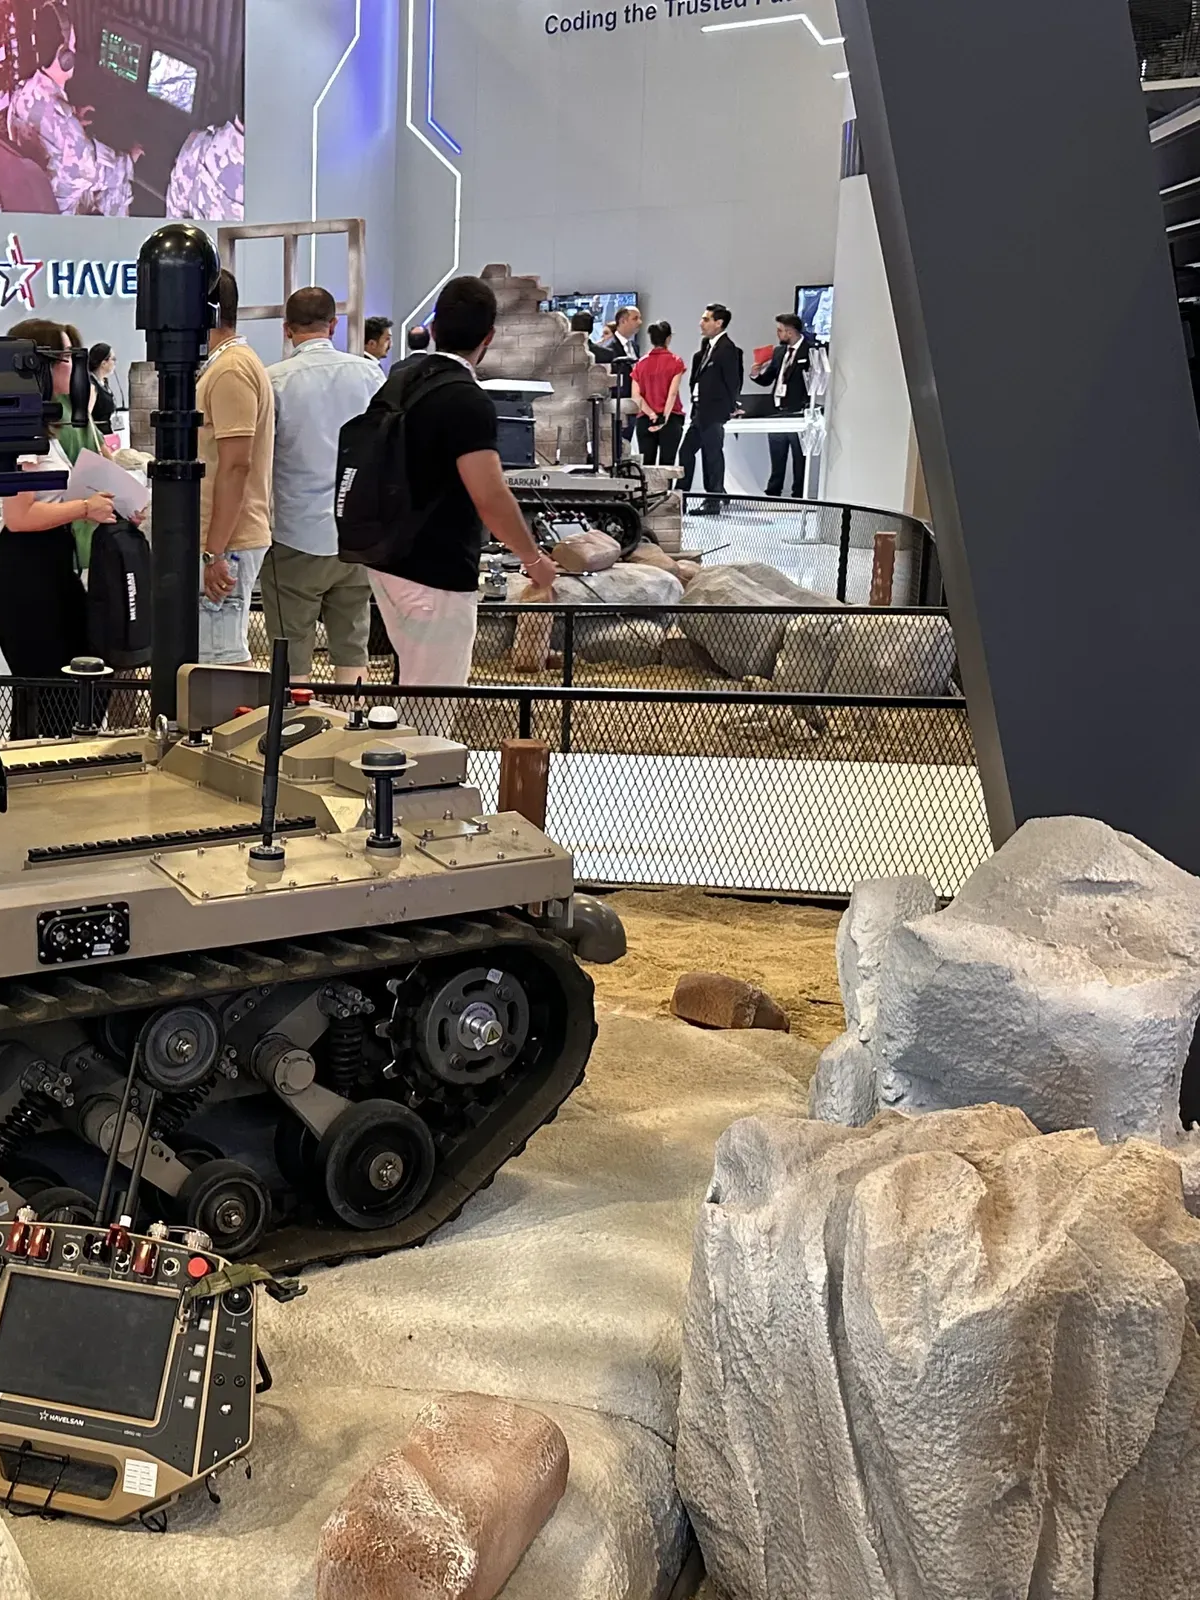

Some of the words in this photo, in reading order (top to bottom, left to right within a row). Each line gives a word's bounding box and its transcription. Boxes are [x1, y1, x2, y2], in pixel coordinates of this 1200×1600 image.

[544, 10, 617, 34] Coding
[624, 3, 657, 24] the
[508, 477, 541, 486] BARKAN
[49, 1414, 85, 1427] HAVELSAN
